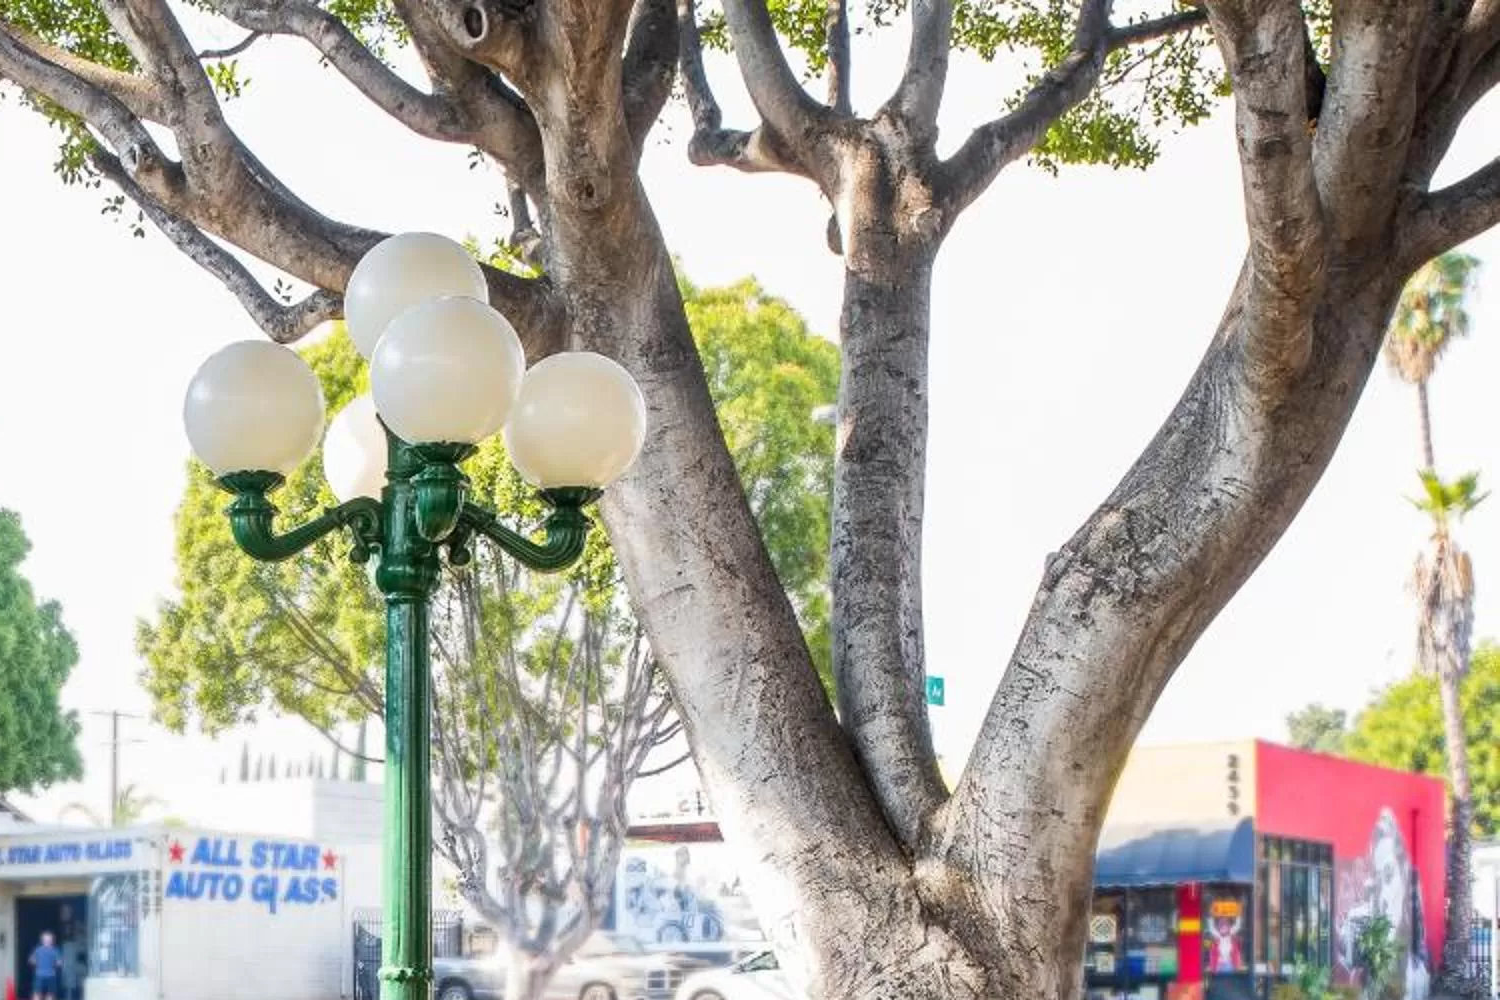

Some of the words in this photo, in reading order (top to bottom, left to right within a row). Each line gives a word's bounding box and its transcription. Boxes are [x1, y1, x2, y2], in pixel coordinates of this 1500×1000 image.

[8, 844, 40, 864] STAR
[44, 842, 81, 863] AUTO
[85, 838, 133, 861] GLASS
[190, 837, 242, 867] ALL
[250, 841, 320, 870] STAR
[166, 872, 244, 900] AUTO
